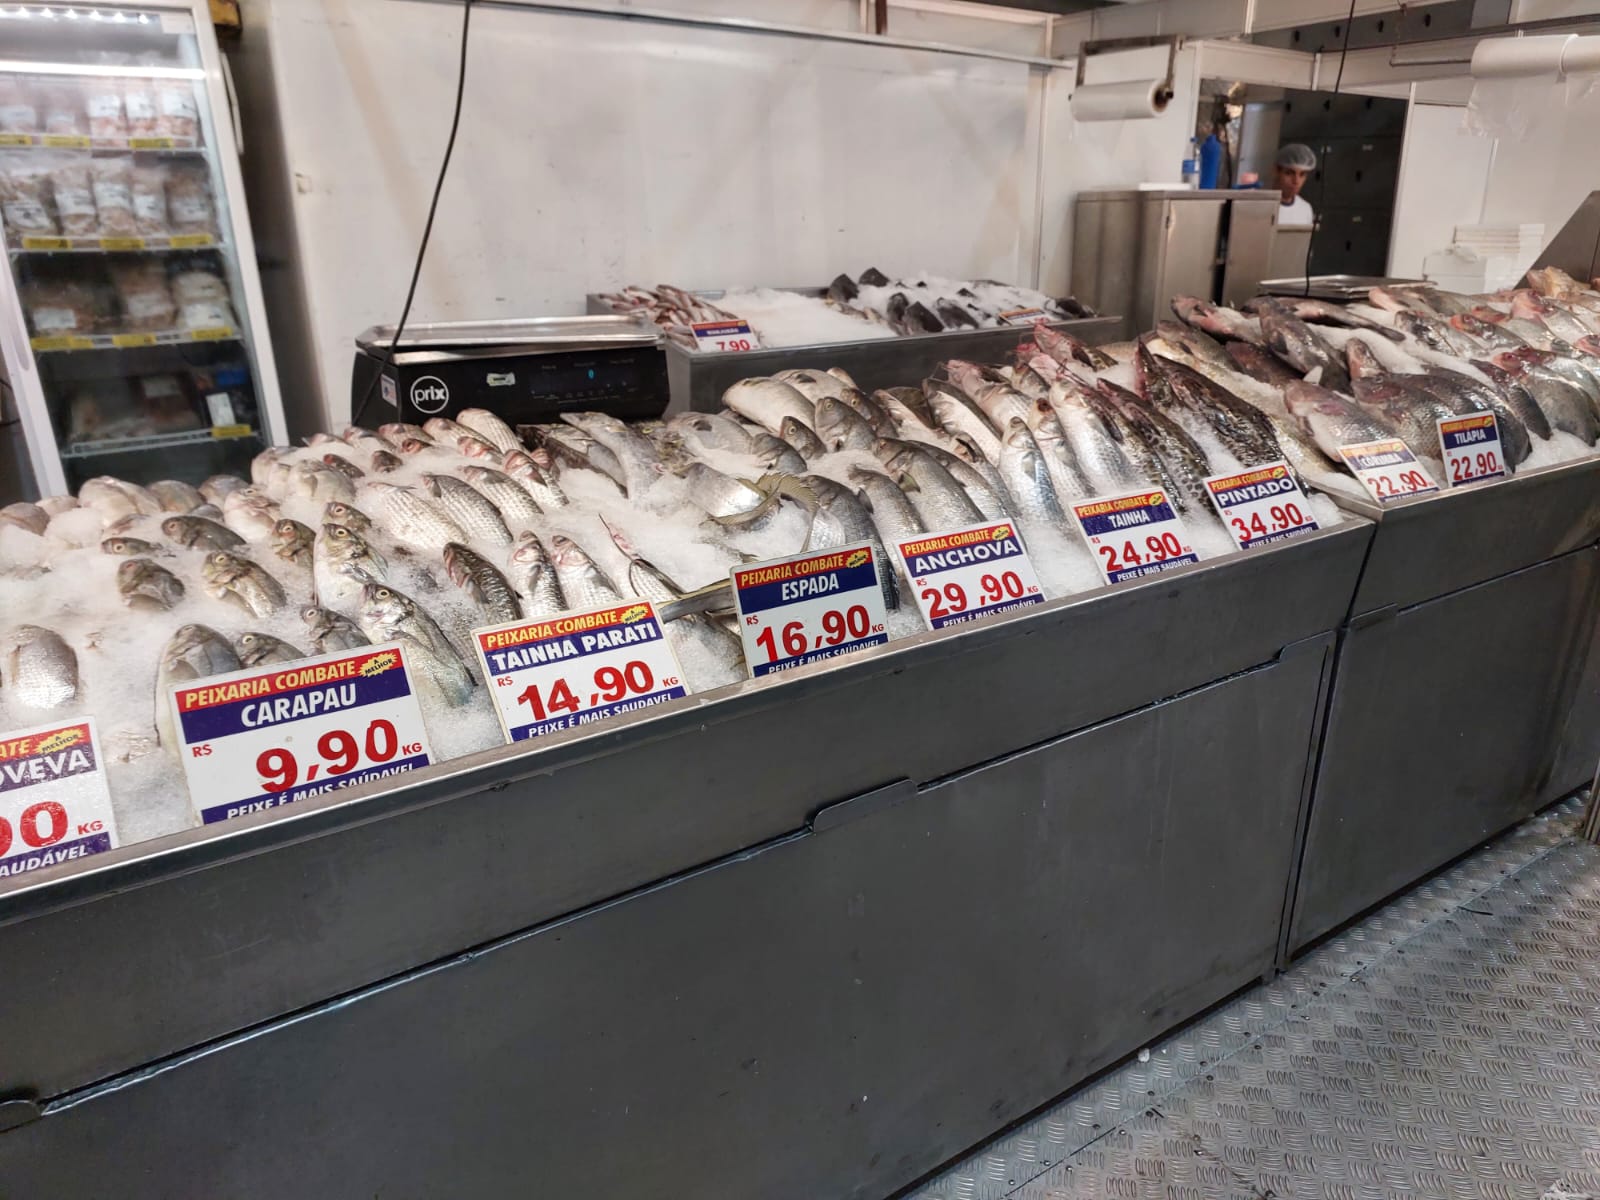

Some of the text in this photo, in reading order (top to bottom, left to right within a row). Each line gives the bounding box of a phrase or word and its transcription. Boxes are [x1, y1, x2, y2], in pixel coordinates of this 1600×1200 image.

[414, 385, 446, 403] prix
[1451, 451, 1497, 481] 22,90
[1217, 478, 1293, 506] PINTADO
[1367, 470, 1427, 497] 22,90
[1108, 509, 1150, 528] TAINHA
[1231, 503, 1303, 541] 34,90
[904, 539, 947, 555] PEIXARIA
[949, 529, 990, 546] COMBATE
[915, 539, 1018, 573] ANCHOVA
[1099, 532, 1182, 572] 24,90
[741, 555, 844, 587] PEIXARIA COMBATE
[782, 573, 839, 601] ESPADA
[921, 571, 1024, 619] 29,90
[1027, 585, 1039, 594] KG
[487, 610, 617, 648] PEIXARIA COMBATE
[756, 605, 870, 663] 16,90
[871, 624, 884, 633] KG
[492, 623, 657, 671] TAINHA PARATI
[364, 657, 393, 676] MELHOR
[663, 676, 679, 687] KG
[185, 660, 356, 708] PEIXARIA COMBATE
[517, 660, 654, 721] 14,90
[241, 683, 356, 727] CARAPAU
[528, 720, 564, 738] PEIXE
[568, 715, 576, 728] É
[580, 708, 610, 725] MAIS
[42, 734, 79, 751] MELHOR
[256, 719, 398, 793] 9,90
[402, 743, 422, 756] KG
[0, 749, 90, 787] VEVA
[226, 801, 273, 819] PEIXE
[293, 784, 334, 802] MAIS
[0, 801, 68, 859] 0
[78, 821, 103, 835] KG
